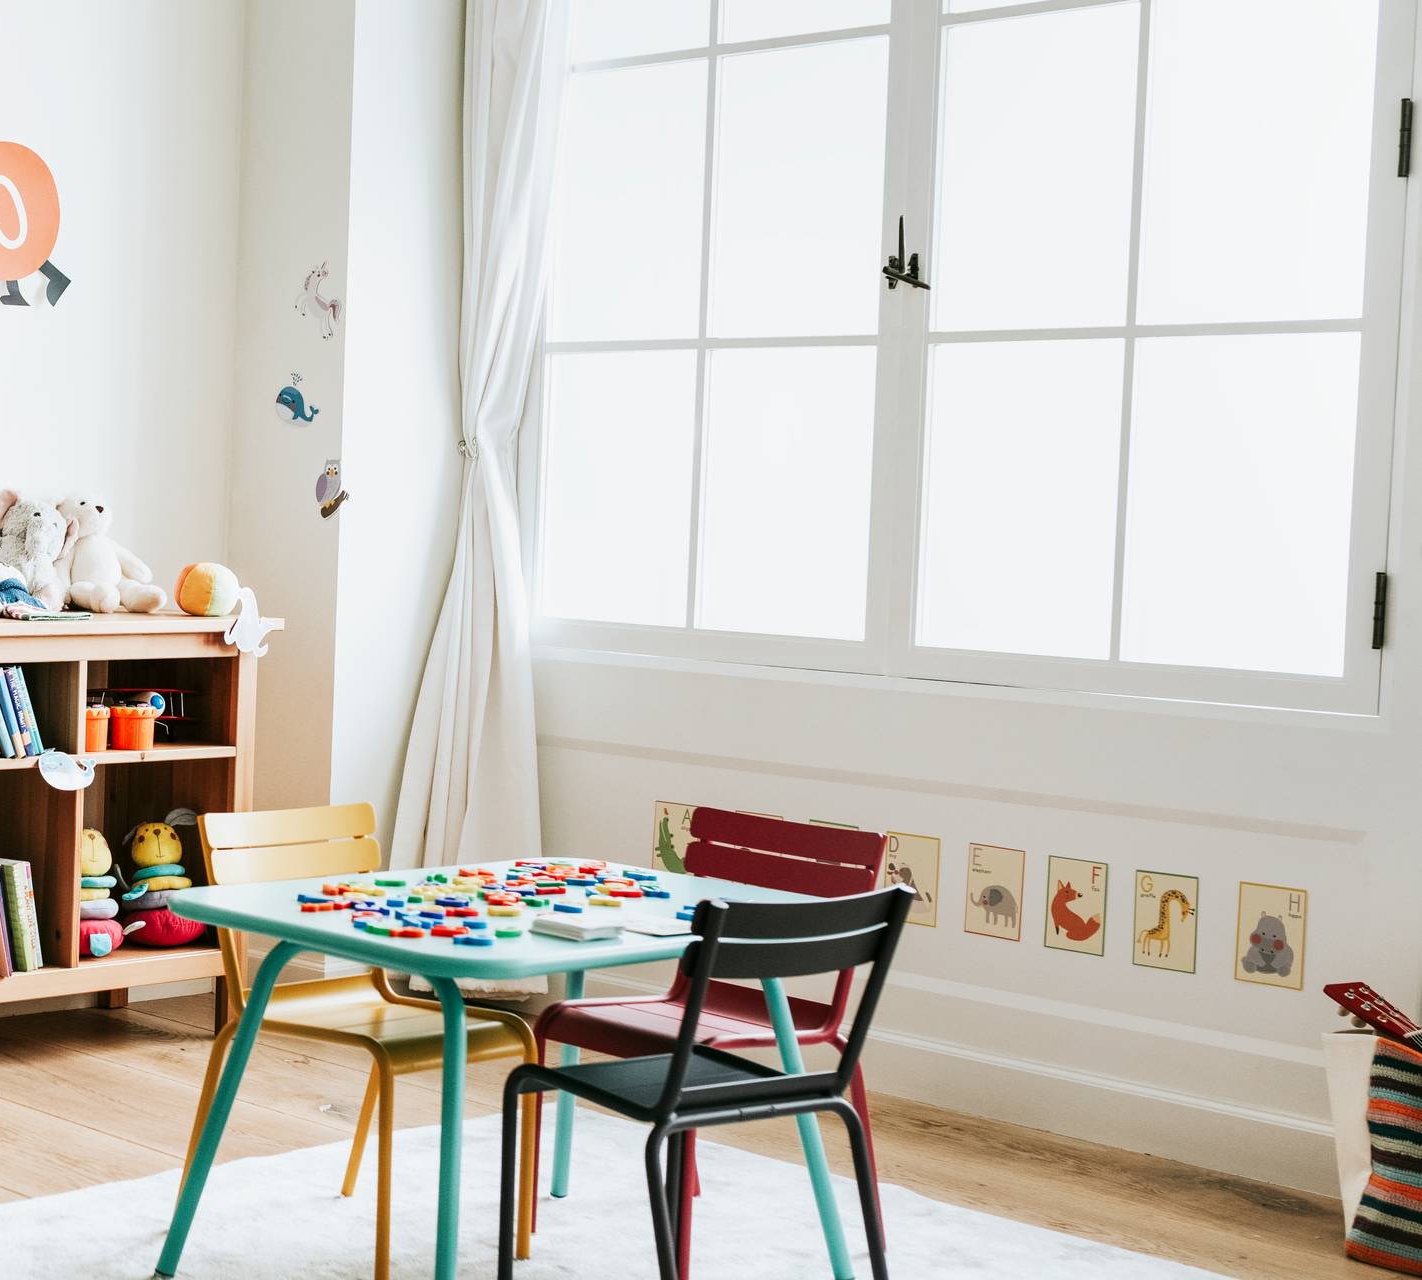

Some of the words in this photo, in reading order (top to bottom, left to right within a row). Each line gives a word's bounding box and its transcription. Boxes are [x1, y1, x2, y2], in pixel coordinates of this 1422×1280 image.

[682, 808, 691, 825] A
[889, 835, 899, 853] D
[973, 847, 983, 866] E
[1091, 866, 1102, 884] F
[1140, 874, 1154, 893] G
[1288, 893, 1301, 912] H
